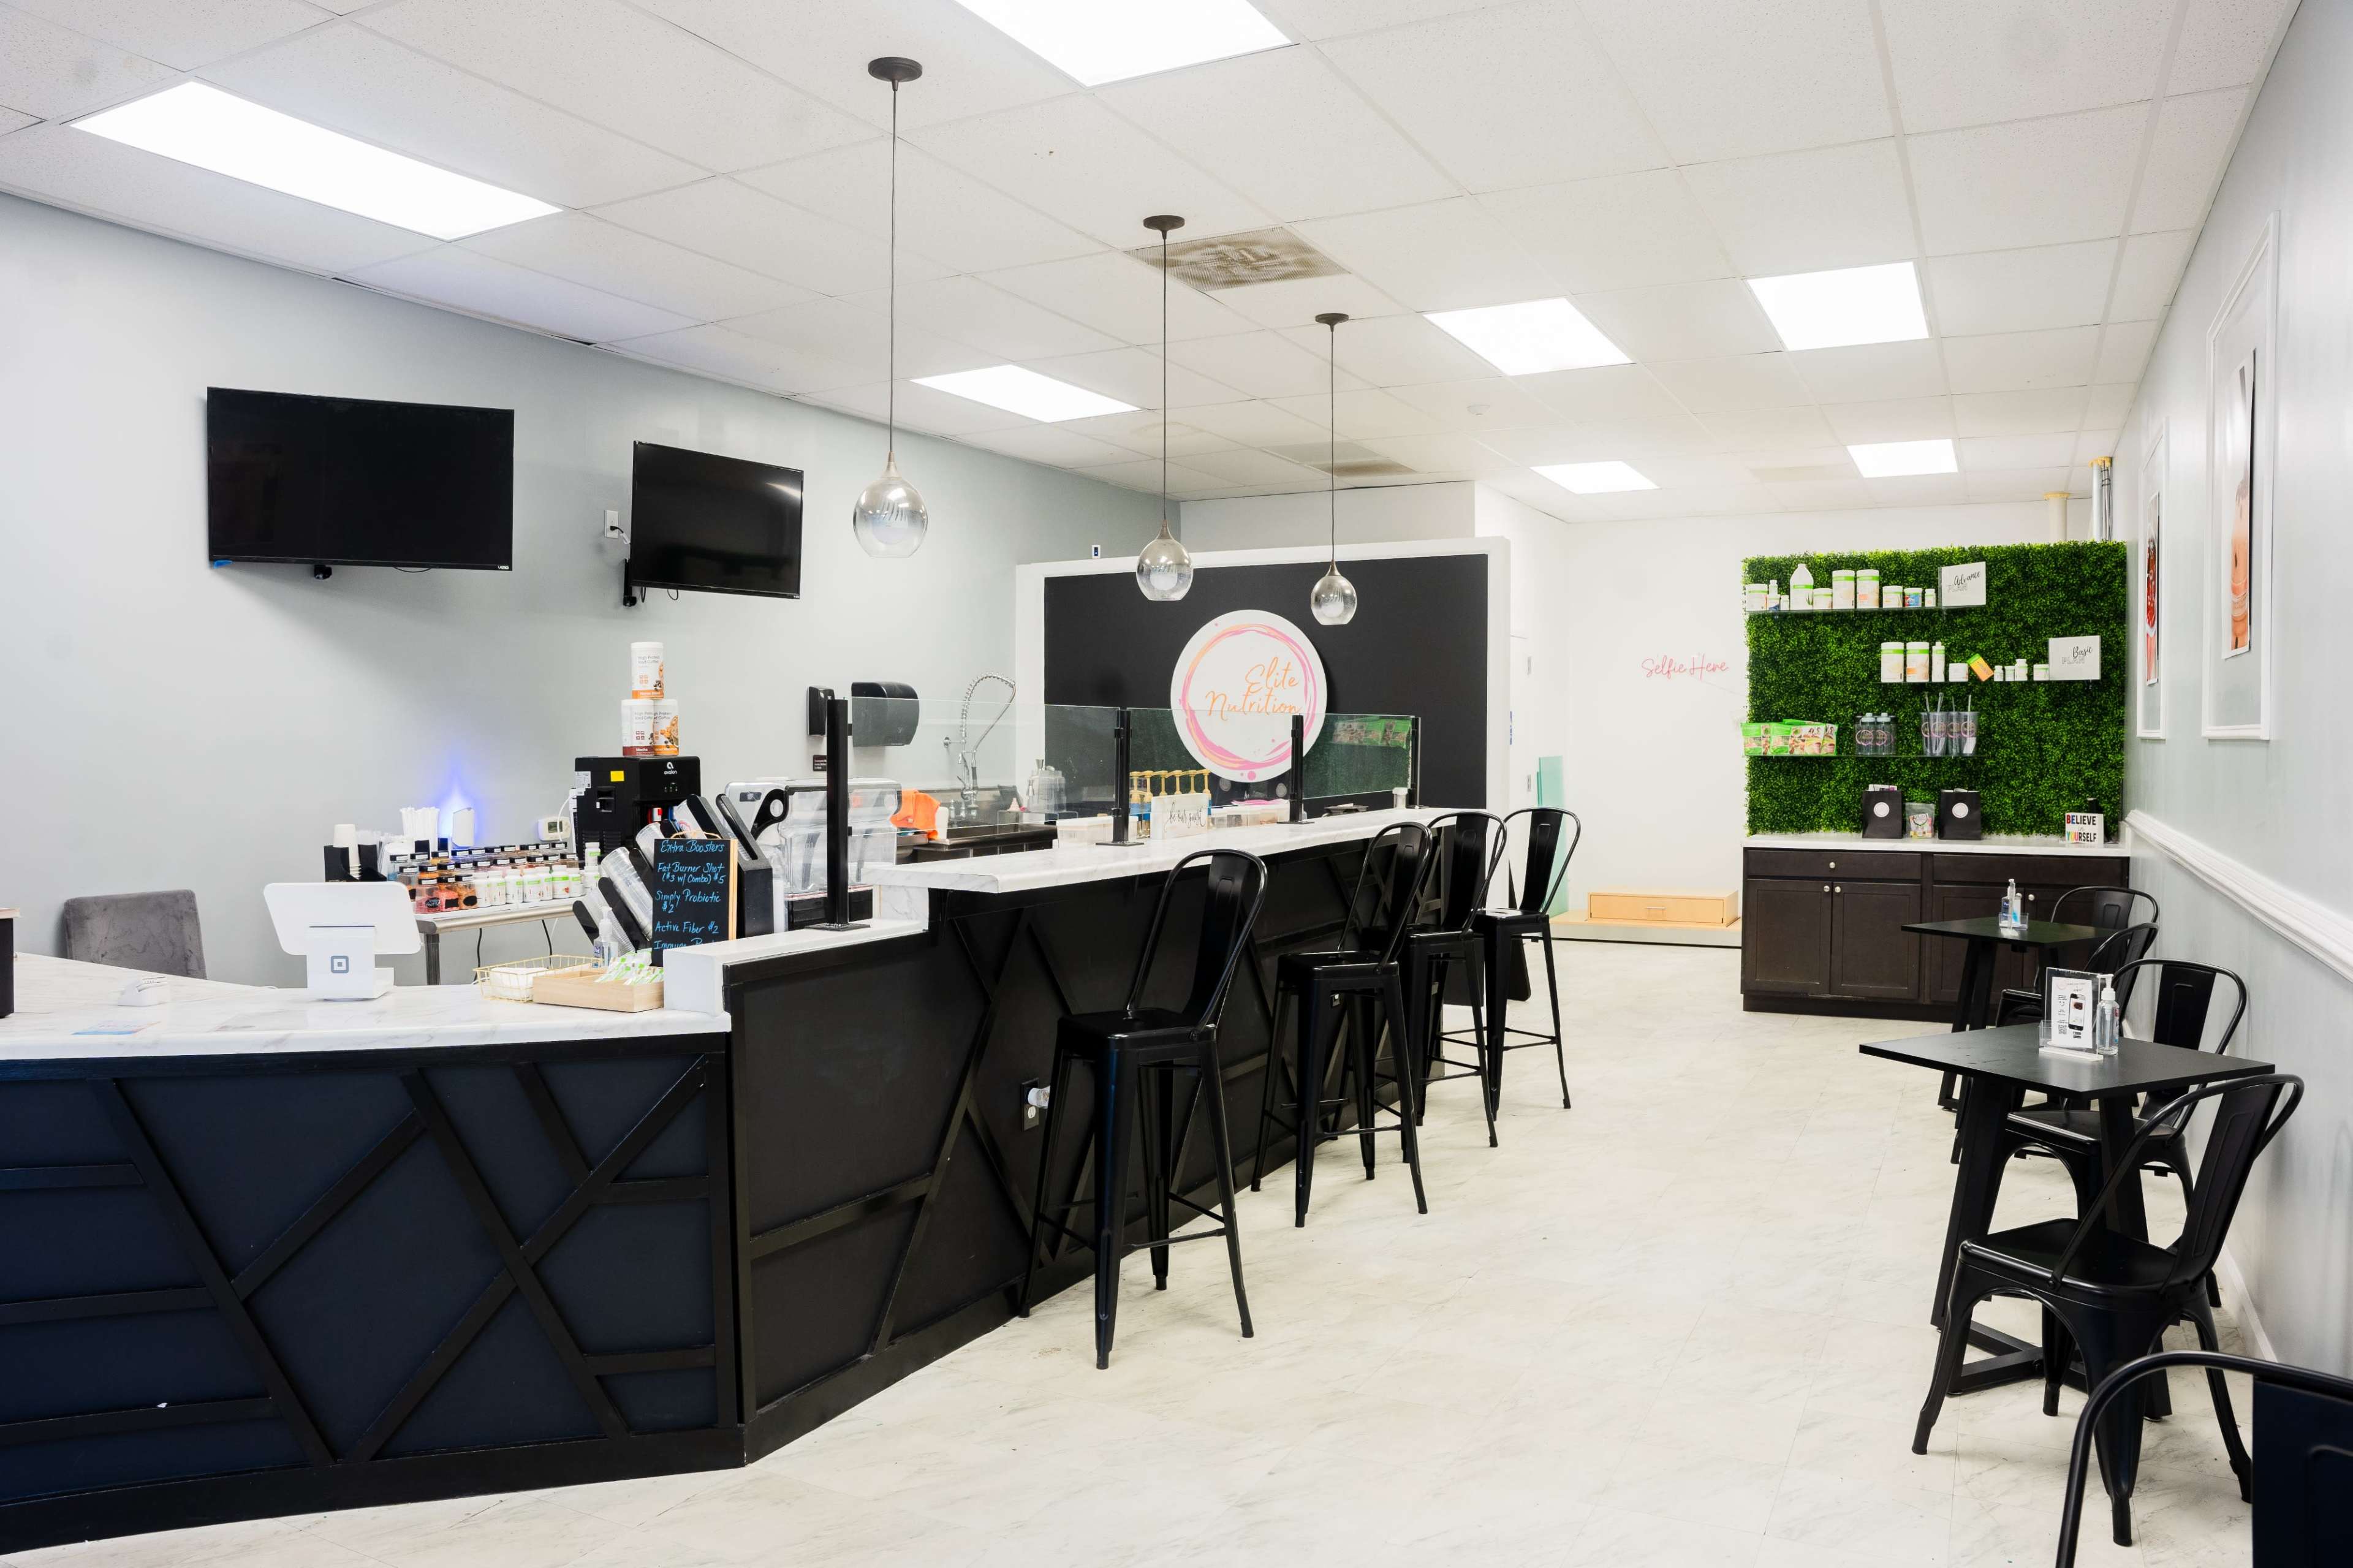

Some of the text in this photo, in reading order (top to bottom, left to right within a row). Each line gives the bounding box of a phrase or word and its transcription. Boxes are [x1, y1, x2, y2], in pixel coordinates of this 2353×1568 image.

[1954, 572, 1980, 586] Advance
[2073, 646, 2093, 659] Basic
[1641, 653, 1729, 680] Selfie Here
[1245, 656, 1300, 694] Elite
[1205, 687, 1302, 721] Nutrition
[2067, 814, 2096, 825] BELIEVE
[2066, 831, 2096, 843] YOURSELF
[661, 840, 725, 853] Extra Boosters
[657, 862, 725, 873] Fat Burner Shot
[662, 873, 726, 886] ($3 w/ Combo) $5
[655, 888, 721, 907] Simply Probiotic
[662, 901, 674, 914] $2
[655, 921, 719, 934] Active Fiber $2
